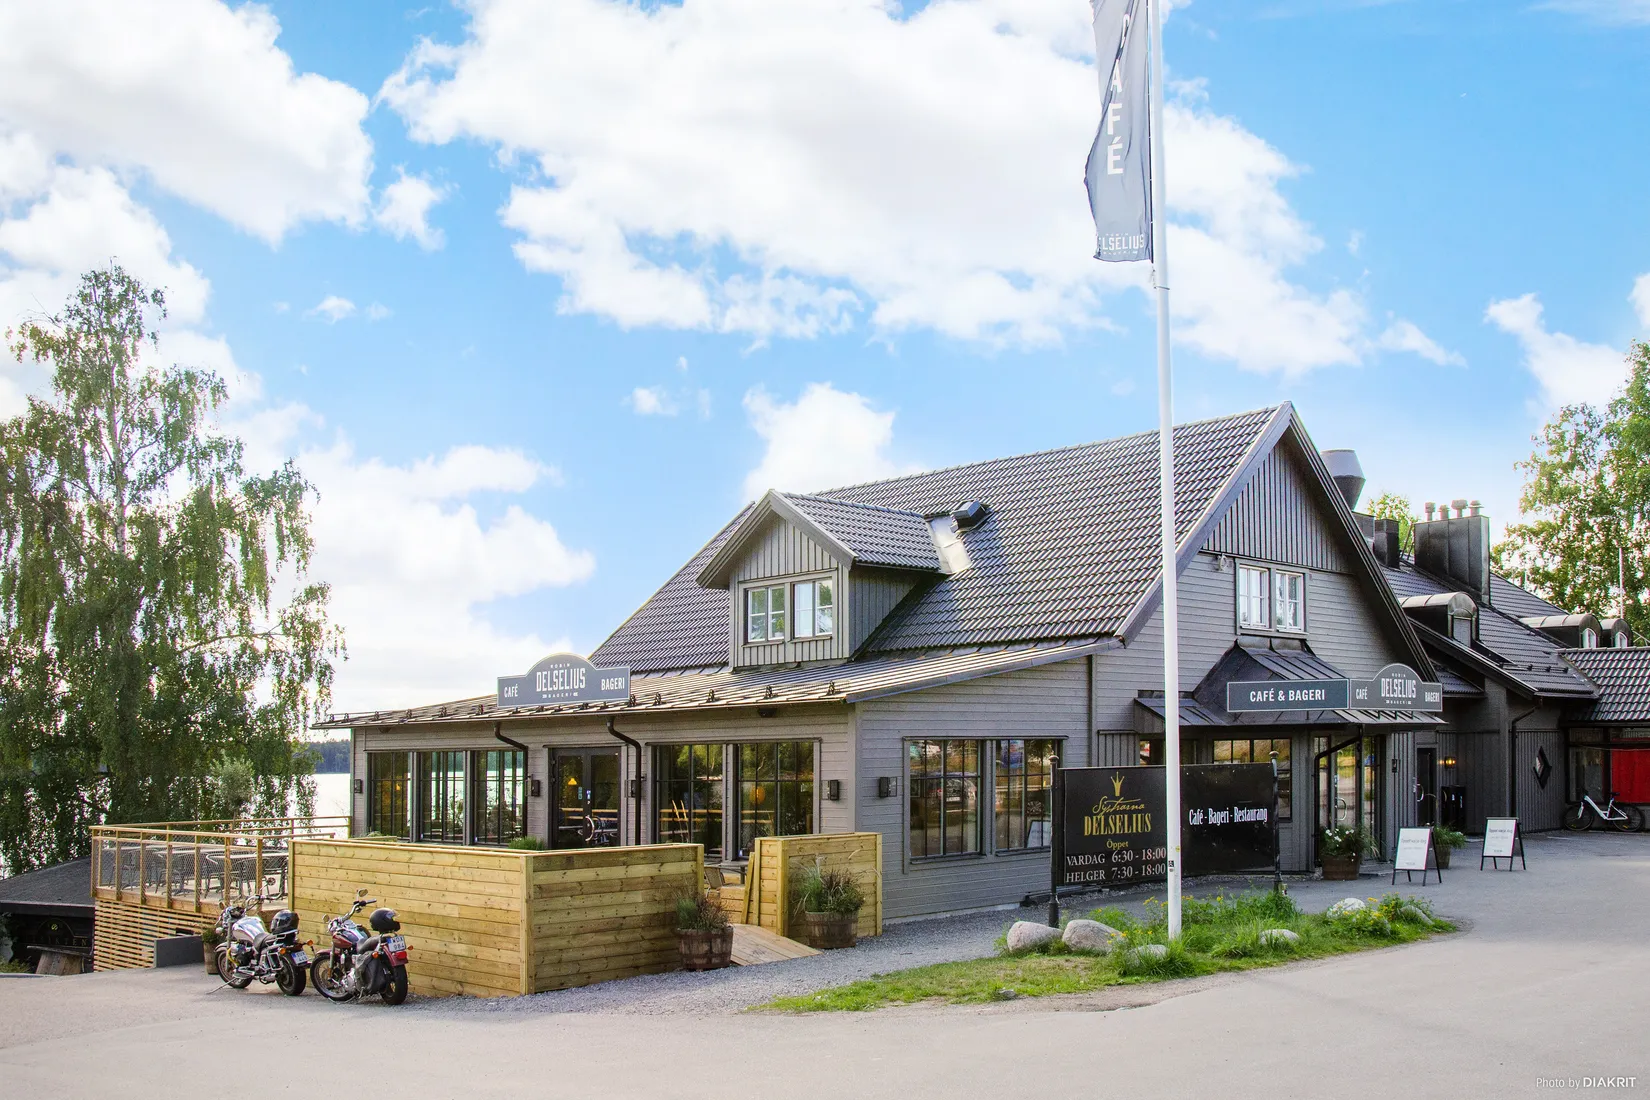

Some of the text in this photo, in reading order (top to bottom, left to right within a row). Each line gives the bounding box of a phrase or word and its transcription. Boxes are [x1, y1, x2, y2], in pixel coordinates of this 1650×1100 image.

[1099, 233, 1144, 250] LSELIUS
[536, 667, 586, 692] DELSELIUS
[600, 677, 625, 691] BAGERI
[1381, 678, 1416, 698] DELSELIUS
[503, 683, 519, 698] CAFÉ
[1249, 688, 1325, 702] CAFÉ & BAGERI
[1355, 686, 1368, 700] CAFÉ
[1424, 692, 1441, 703] BAGERI
[1092, 795, 1145, 817] Systrarna
[1083, 813, 1152, 836] DELSELIUS
[1189, 808, 1204, 825] Café
[1208, 807, 1229, 826] Bageri
[1234, 806, 1268, 825] Restaurang
[1106, 839, 1129, 851] Öppet
[1066, 853, 1106, 866] VARDAG
[1111, 850, 1133, 863] 6:30
[1142, 847, 1167, 860] 18:00
[1066, 870, 1106, 883] HELGER
[1111, 866, 1133, 879] 7:30
[1142, 863, 1166, 876] 18:00
